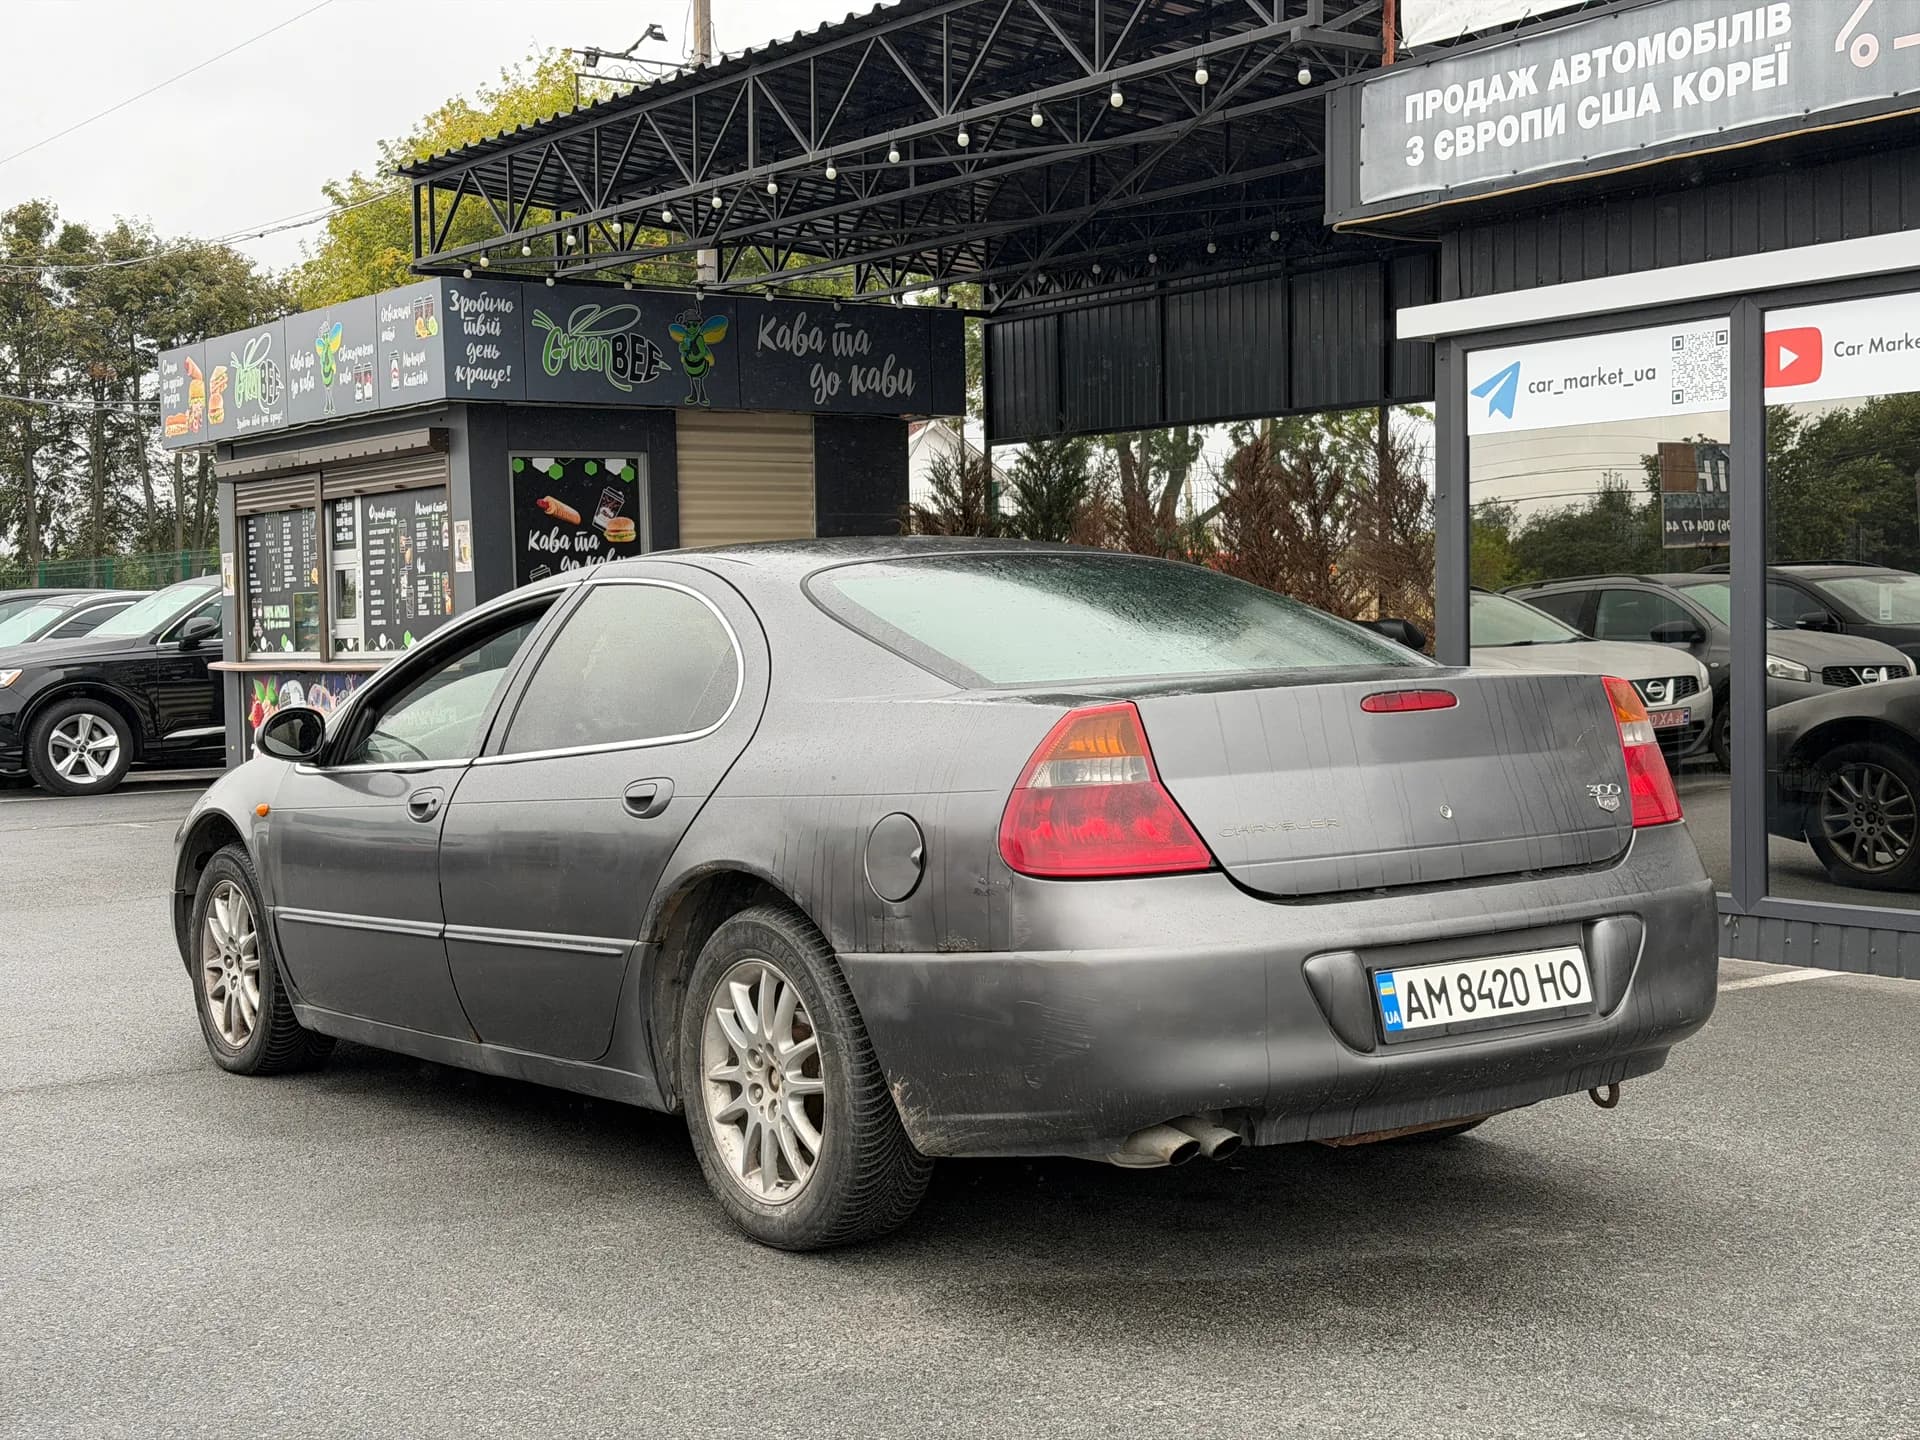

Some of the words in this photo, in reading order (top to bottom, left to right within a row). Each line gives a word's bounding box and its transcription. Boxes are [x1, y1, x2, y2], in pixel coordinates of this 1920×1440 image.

[1405, 71, 1538, 123] ПРОДАЖ
[1547, 1, 1791, 92] АВТОМОБІЛІВ
[1405, 136, 1424, 167] З
[1434, 103, 1566, 160] ЄВРОПИ
[1578, 83, 1661, 129] США
[1672, 41, 1791, 110] КОРЕЇ
[449, 290, 514, 319] Зробимо
[463, 313, 501, 336] твій
[758, 312, 827, 356] Кава
[832, 323, 872, 357] та
[466, 342, 501, 364] день
[1834, 341, 1863, 357] Car
[455, 365, 511, 390] краще!
[810, 363, 842, 405] до
[848, 353, 916, 398] кави
[1528, 366, 1656, 395] car_market_ua
[528, 526, 571, 553] Кава
[574, 531, 600, 552] та
[1219, 818, 1339, 838] CHRYSLER
[1407, 976, 1453, 1022] AM
[1457, 967, 1530, 1013] 8420
[1535, 959, 1582, 1003] HO
[1385, 1011, 1401, 1024] UA
